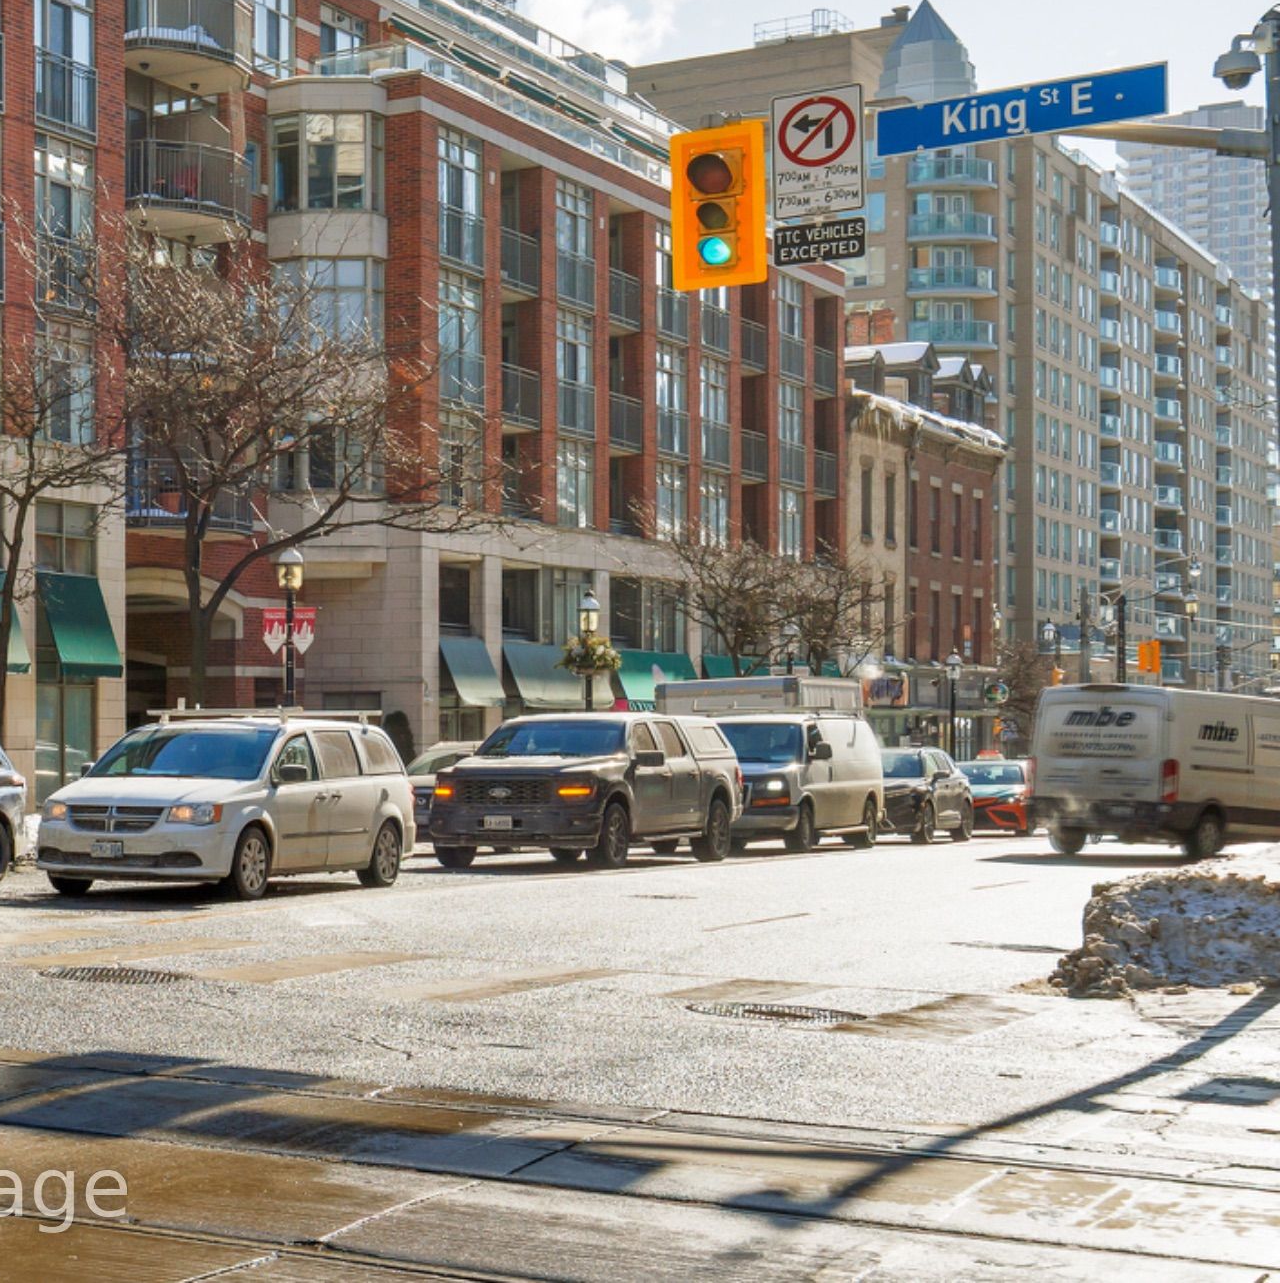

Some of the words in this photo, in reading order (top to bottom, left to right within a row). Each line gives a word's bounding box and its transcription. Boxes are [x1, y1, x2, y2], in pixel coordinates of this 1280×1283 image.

[942, 98, 1027, 135] King
[1040, 87, 1060, 106] St
[1071, 81, 1094, 115] E
[776, 230, 801, 245] TTC
[806, 222, 864, 241] VEHICLES
[781, 240, 860, 260] EXCEPTED
[1063, 706, 1138, 727] mbe
